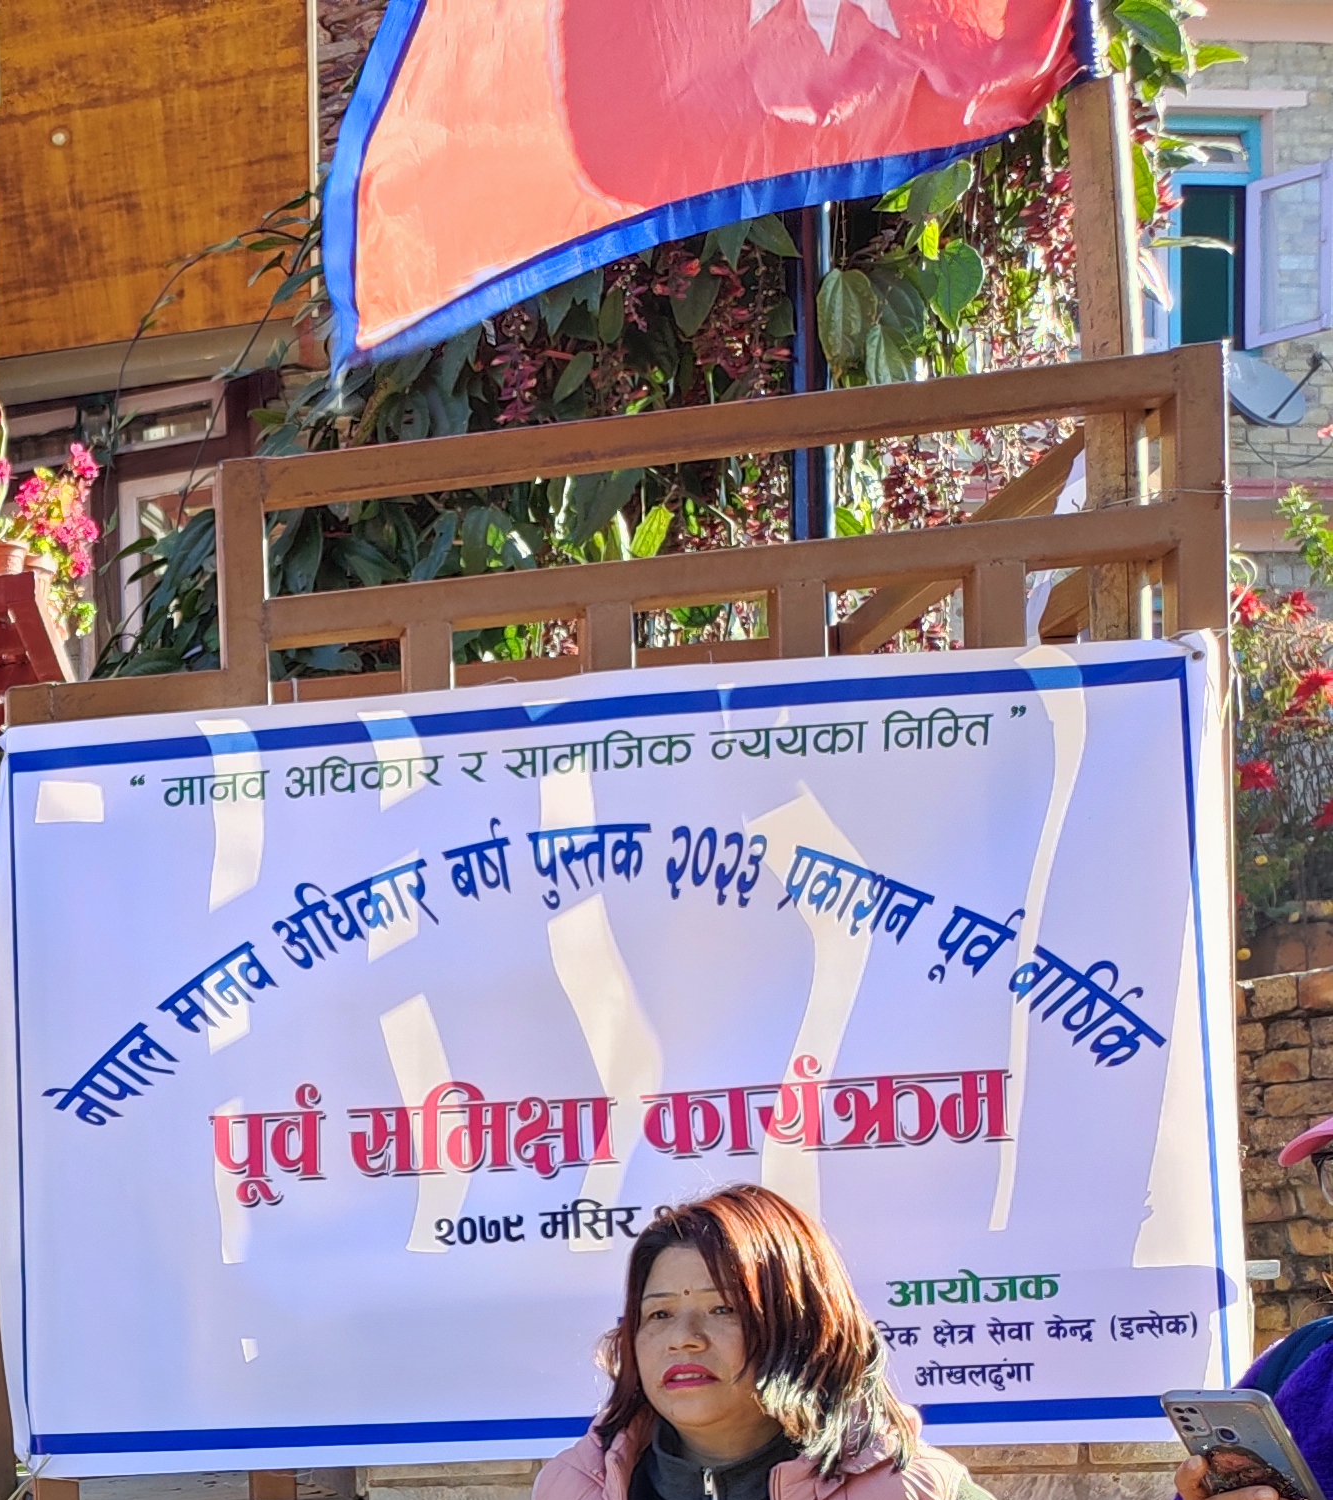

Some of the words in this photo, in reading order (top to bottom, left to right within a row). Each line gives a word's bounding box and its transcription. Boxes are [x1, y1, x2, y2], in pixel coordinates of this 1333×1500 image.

[161, 769, 271, 807] मानव
[283, 755, 445, 800] अधिकार
[458, 751, 488, 783] र
[501, 729, 696, 780] सामाजिक
[708, 720, 869, 760] न्ययका
[881, 706, 994, 752] निम्ति
[41, 1021, 181, 1127] नेपाल
[155, 940, 280, 1034] मानव
[271, 857, 440, 970] अधिकार
[441, 817, 512, 902] बर्ष
[526, 823, 652, 911] पुस्तक
[666, 825, 768, 909] २०२३
[776, 844, 936, 945] प्रकाशन
[927, 904, 1026, 984] पूर्व
[1008, 944, 1167, 1068] बार्षिक
[207, 1082, 327, 1207] पूर्व
[346, 1080, 620, 1179] समिक्षा
[639, 1053, 1015, 1160] कार्यक्रम
[434, 1213, 526, 1246] २०७९
[538, 1198, 642, 1241] मंसिर
[886, 1268, 1061, 1307] आयोजक
[873, 1319, 922, 1352] रिक
[932, 1318, 976, 1349] क्षेत्र
[986, 1316, 1035, 1345] सेवा
[1043, 1314, 1097, 1343] केन्द्र
[1109, 1309, 1199, 1343] (इन्सेक)
